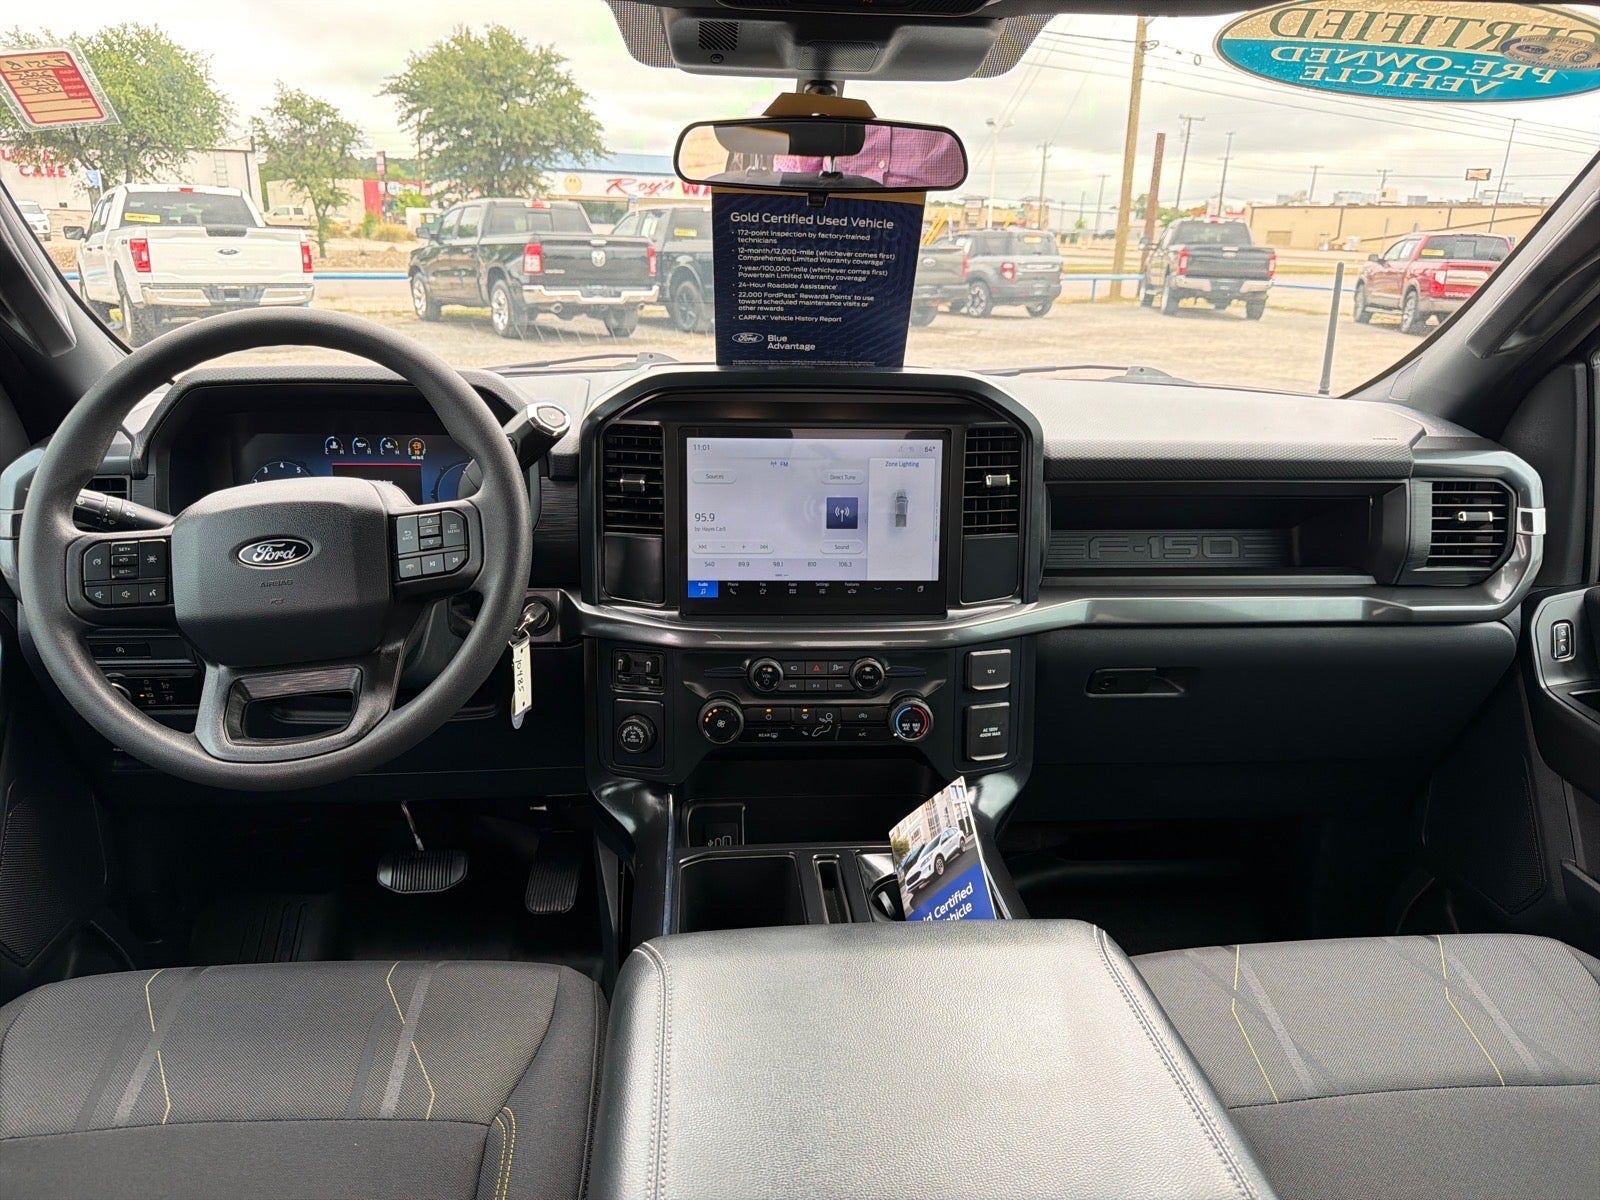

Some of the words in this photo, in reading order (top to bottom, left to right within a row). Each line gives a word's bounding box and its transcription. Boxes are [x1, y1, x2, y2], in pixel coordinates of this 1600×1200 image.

[19, 164, 67, 178] CARE
[730, 212, 760, 223] Gold
[762, 212, 814, 226] Certified
[816, 215, 848, 227] Used
[850, 217, 895, 230] Vehicle
[737, 229, 769, 238] 172-point
[770, 230, 807, 240] inspection
[808, 231, 817, 240] by
[818, 231, 871, 241] factory-trained
[737, 236, 778, 244] technicians
[737, 247, 815, 256] 12-month/12,000-mile
[816, 249, 853, 258] (whichever
[878, 252, 896, 261] first)
[737, 254, 791, 263] Comprehensive
[792, 255, 819, 263] Limited
[819, 256, 852, 266] Warranty
[737, 264, 808, 273] 7-year/100,000-mile
[809, 266, 846, 275] (whichever
[871, 269, 888, 277] first)
[803, 273, 835, 282] Warranty
[737, 281, 766, 289] 24-Hour
[766, 282, 799, 290] Roadside
[737, 291, 763, 299] 22,000
[799, 292, 830, 300] Rewards
[798, 299, 842, 307] maintenance
[843, 300, 861, 308] visits
[767, 342, 816, 352] Advantage
[693, 443, 711, 451] 11:01
[885, 460, 899, 468] Zone
[899, 460, 920, 468] Lighting
[694, 512, 716, 522] 95.9
[1088, 535, 1241, 559] F-150
[252, 543, 296, 562] Ford
[260, 578, 294, 588] AIRBAG
[934, 883, 973, 917] Certified
